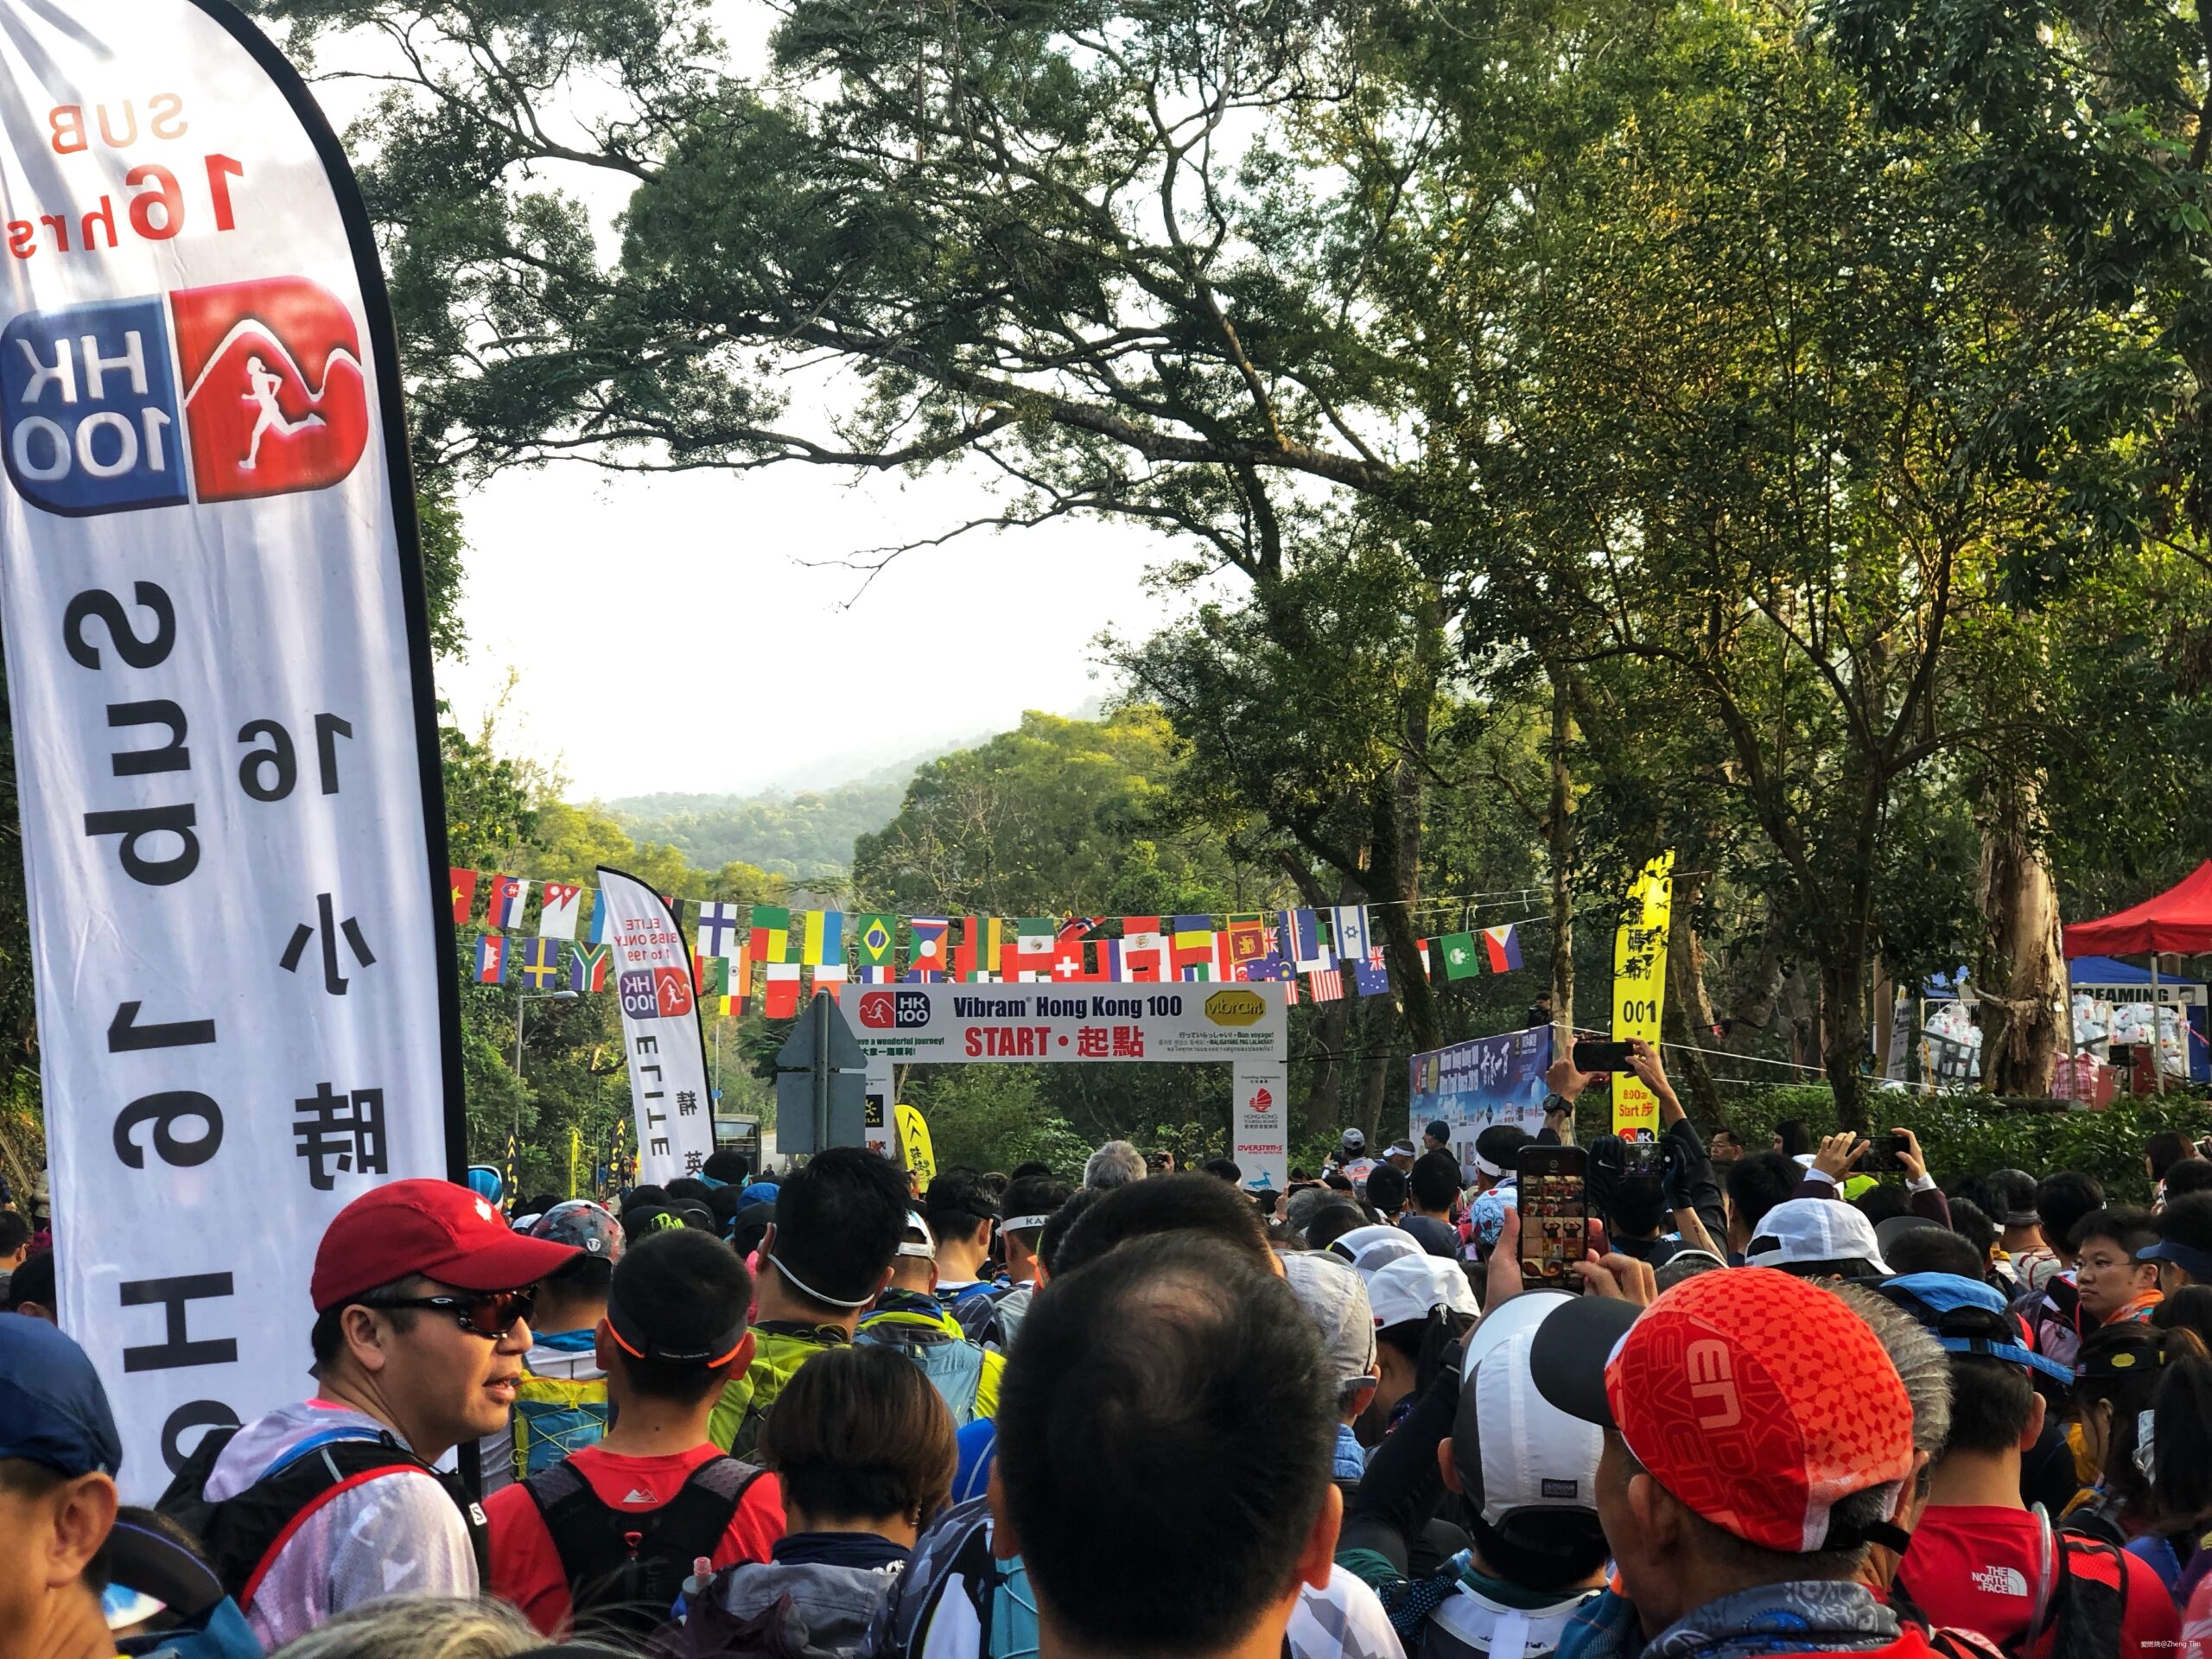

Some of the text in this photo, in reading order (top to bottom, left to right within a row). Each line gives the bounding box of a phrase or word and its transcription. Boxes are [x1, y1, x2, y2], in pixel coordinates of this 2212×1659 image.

[899, 996, 926, 1009] HK
[2072, 988, 2169, 1003] TREAMING
[1036, 996, 1087, 1019] Hong
[1092, 996, 1142, 1019] Kong
[1147, 995, 1182, 1017] 100
[1623, 1000, 1656, 1023] 001
[897, 1009, 929, 1022] 100
[914, 1037, 944, 1046] journey!
[964, 1027, 1052, 1057] START
[1077, 1026, 1145, 1058] 起點
[1623, 1090, 1648, 1100] 8:00a
[1619, 1103, 1639, 1117] Start
[1986, 1566, 2009, 1576] THE
[1971, 1572, 2008, 1586] NORTH
[1982, 1583, 2009, 1594] FACE
